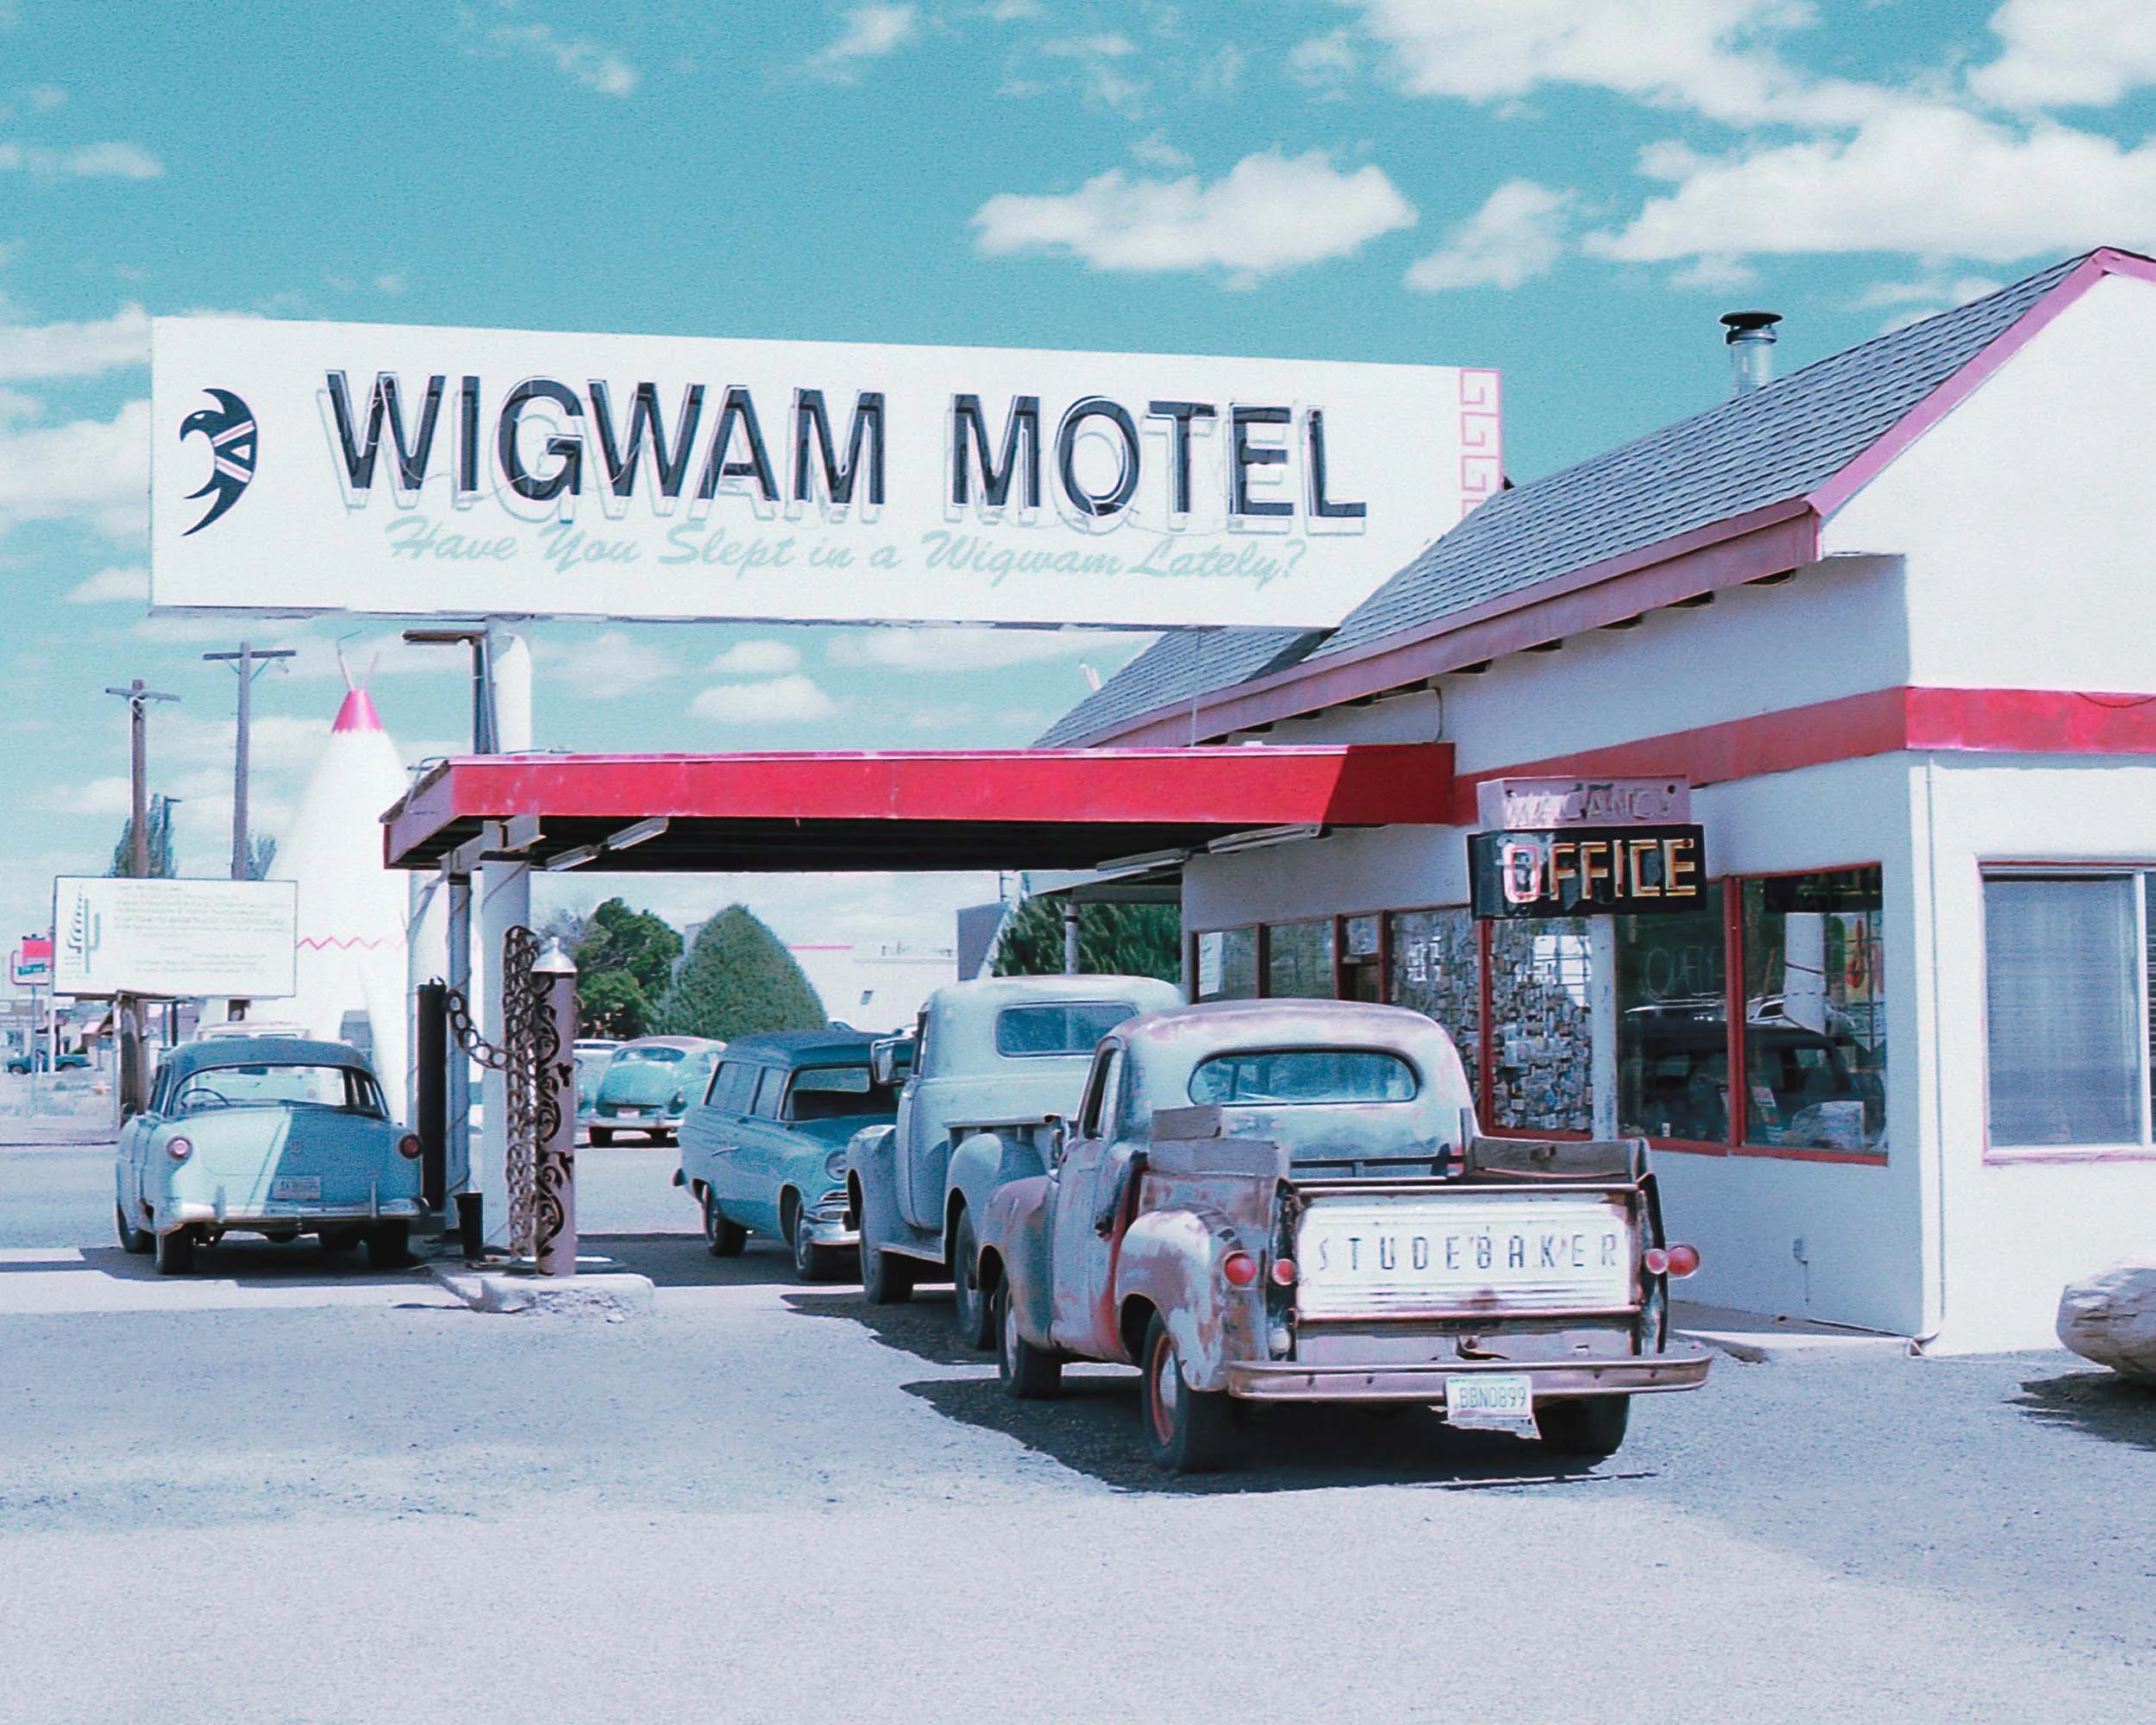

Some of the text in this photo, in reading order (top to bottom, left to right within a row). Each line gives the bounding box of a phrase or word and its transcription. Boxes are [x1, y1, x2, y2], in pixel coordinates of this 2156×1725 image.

[324, 370, 1368, 526] WIGWAM MOTEL
[385, 515, 1307, 592] Have You Slept in a Wigwam Lately?
[1502, 838, 1697, 904] OFFICE
[1317, 1233, 1618, 1272] STUDEBAKER
